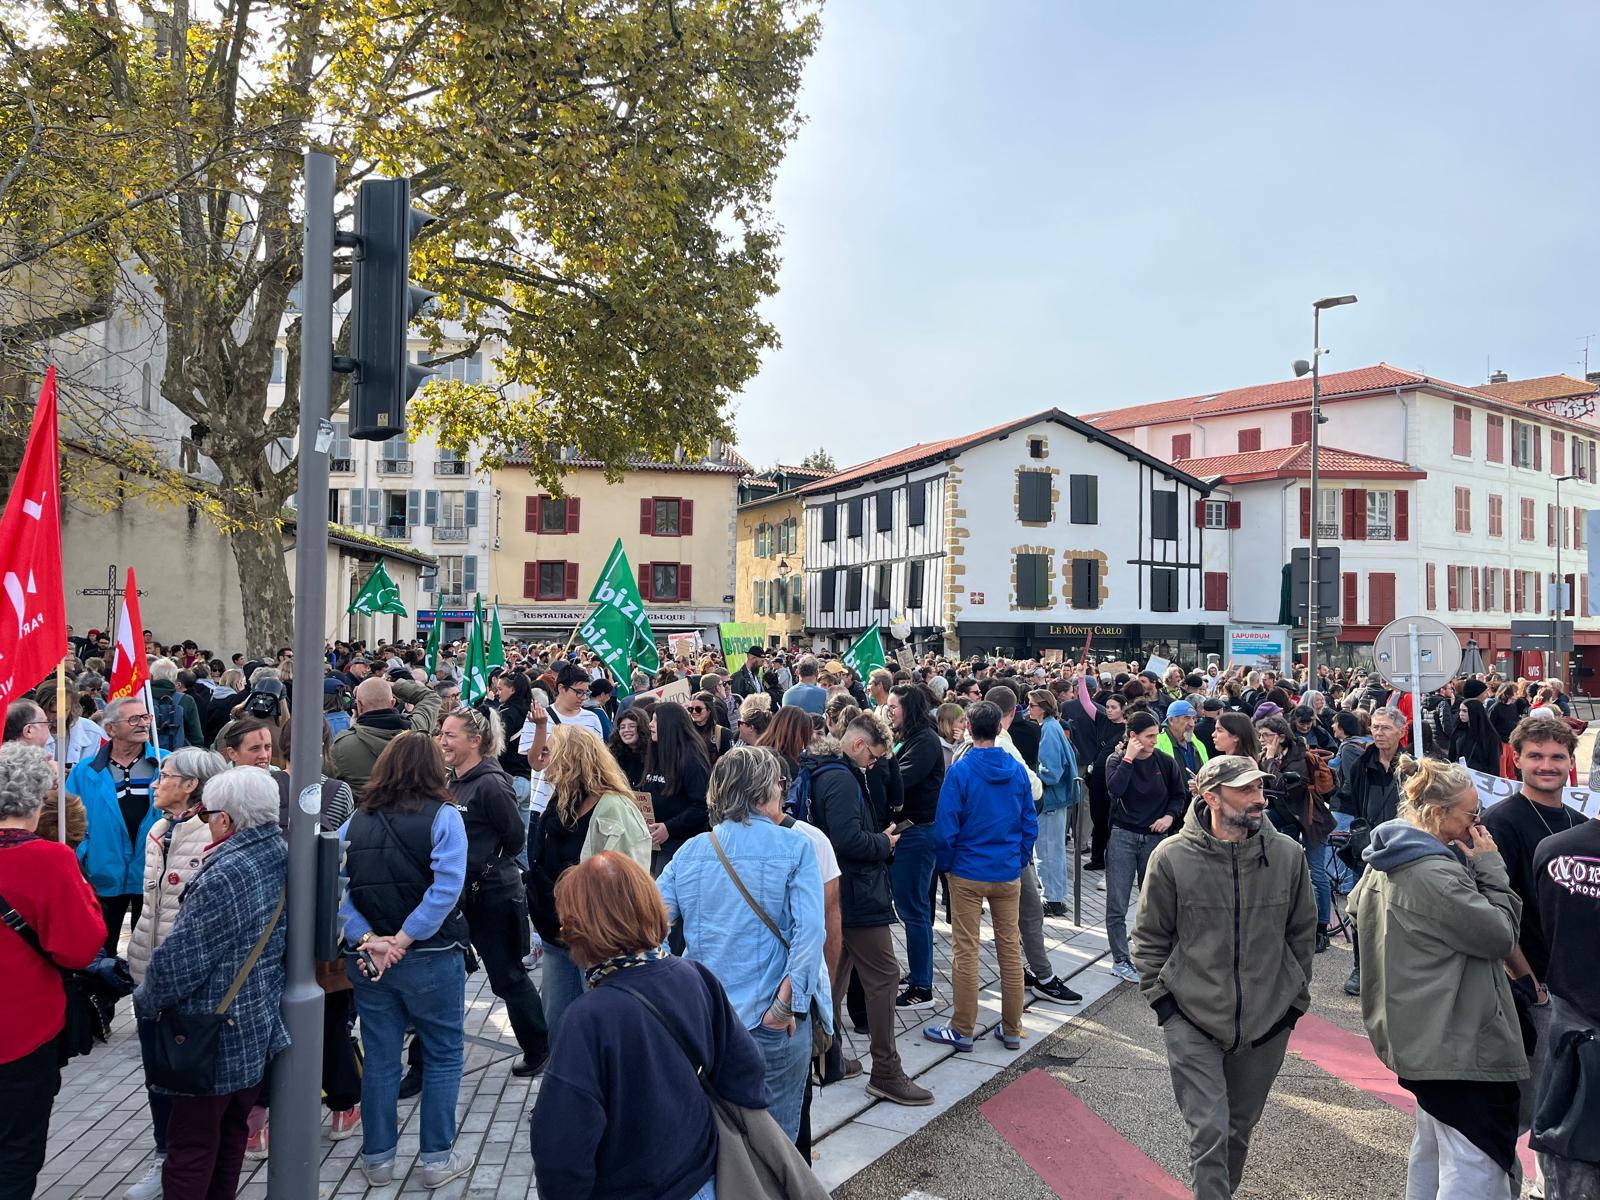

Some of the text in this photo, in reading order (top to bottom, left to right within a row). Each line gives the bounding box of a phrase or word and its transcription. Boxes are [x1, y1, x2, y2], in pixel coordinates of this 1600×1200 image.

[596, 581, 646, 627] bizi
[580, 618, 623, 664] bizi
[1050, 626, 1061, 635] LE
[1095, 626, 1122, 635] CARLO
[1528, 666, 1540, 677] AVIS
